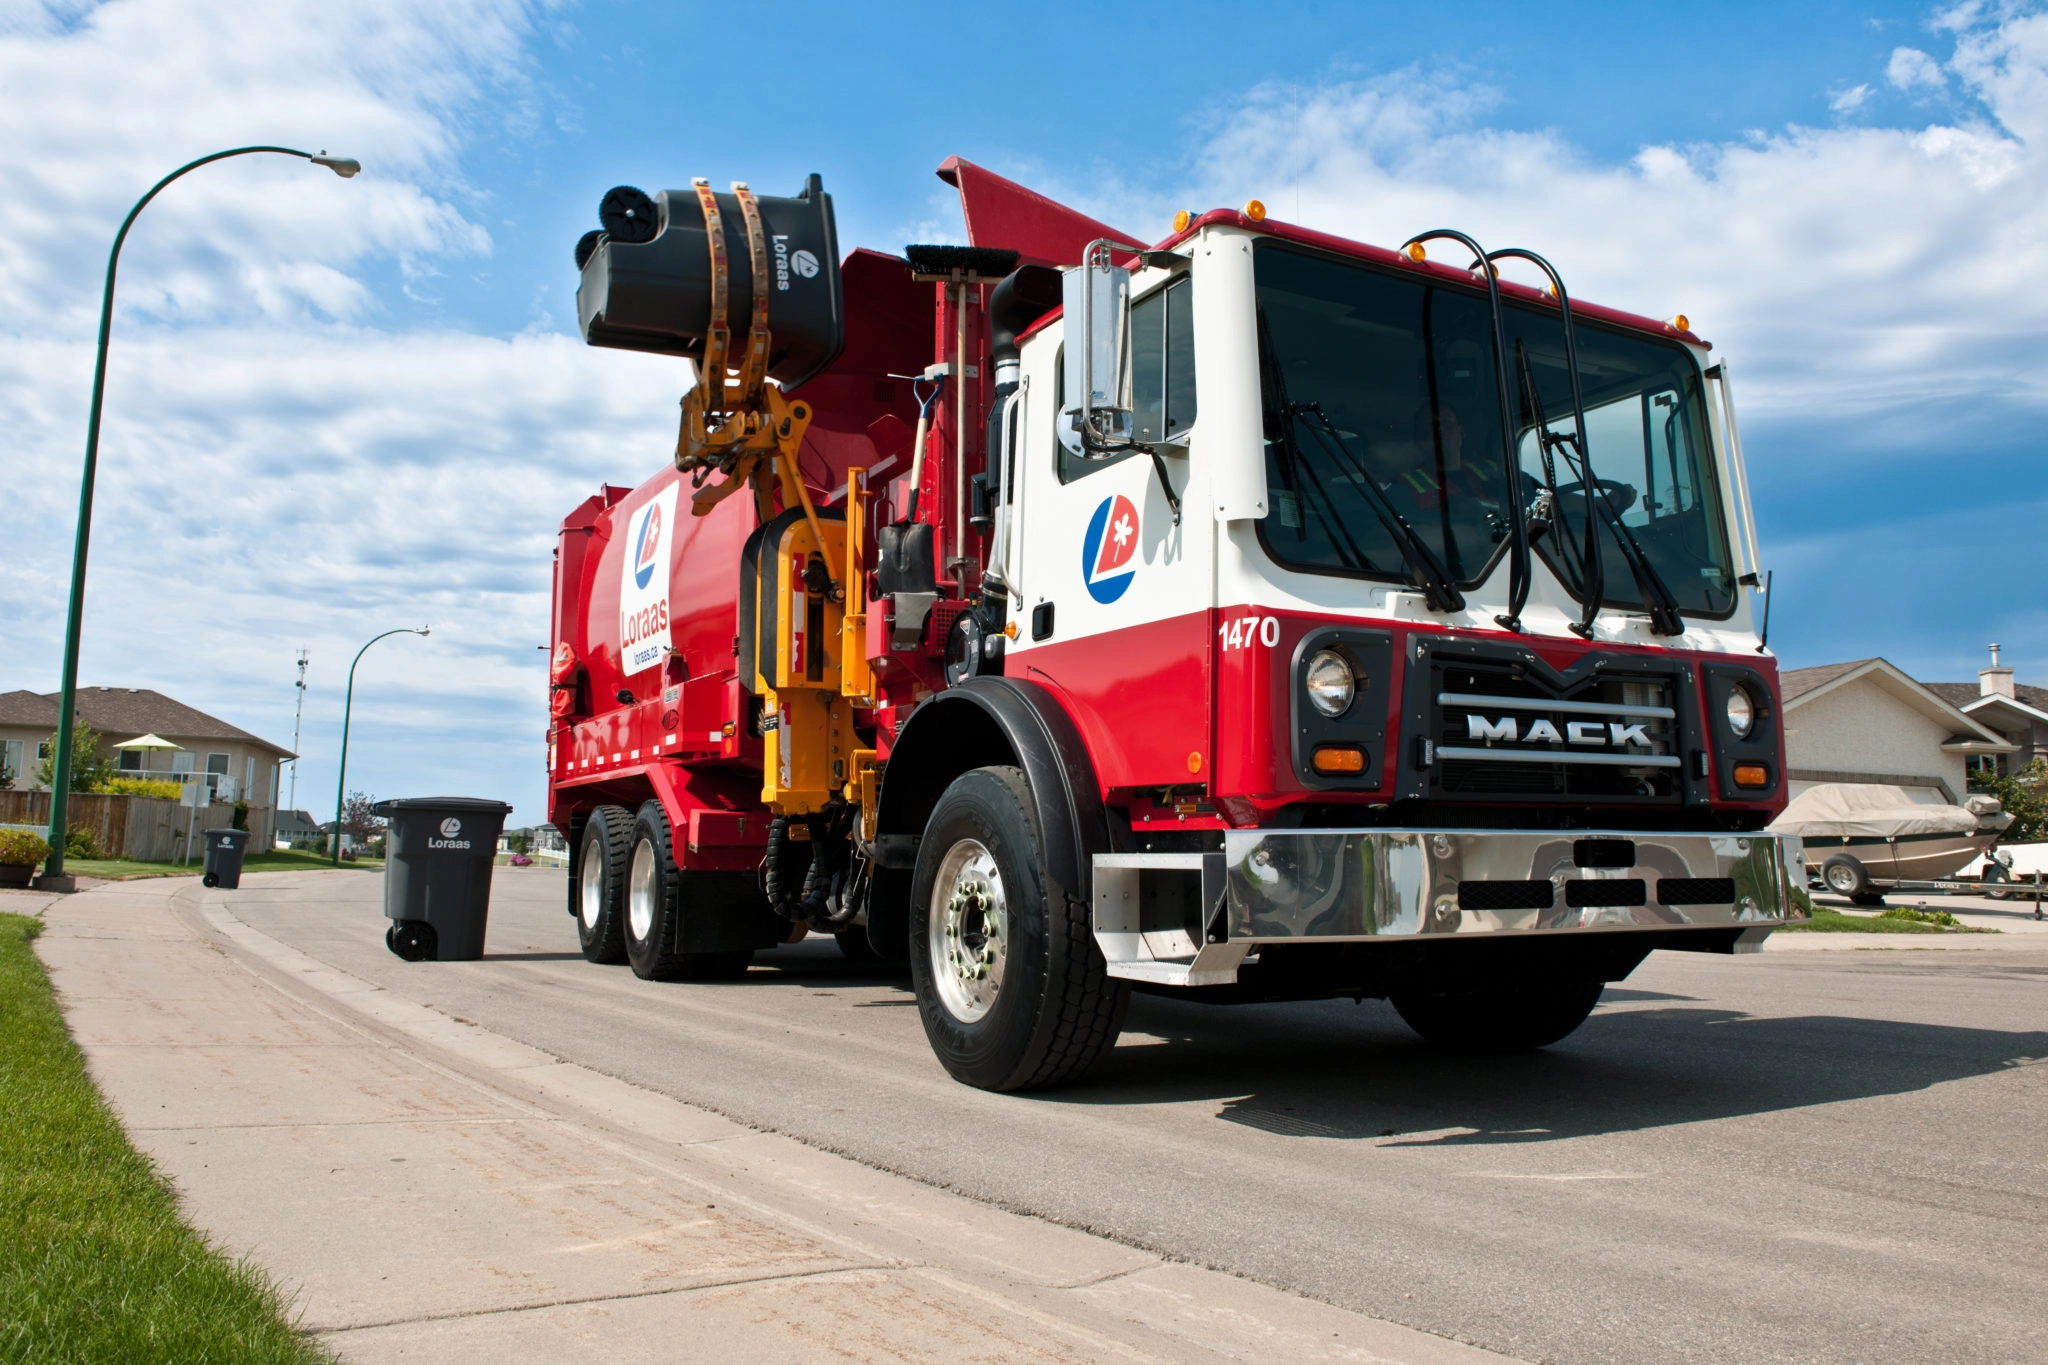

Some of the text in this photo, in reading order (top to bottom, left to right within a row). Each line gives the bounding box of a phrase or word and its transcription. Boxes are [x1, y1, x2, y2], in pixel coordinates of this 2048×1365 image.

[772, 235, 789, 291] Loraas
[622, 599, 668, 648] Loraas
[1219, 616, 1280, 652] 1470
[1467, 714, 1652, 747] MACK
[428, 837, 471, 849] Loraas
